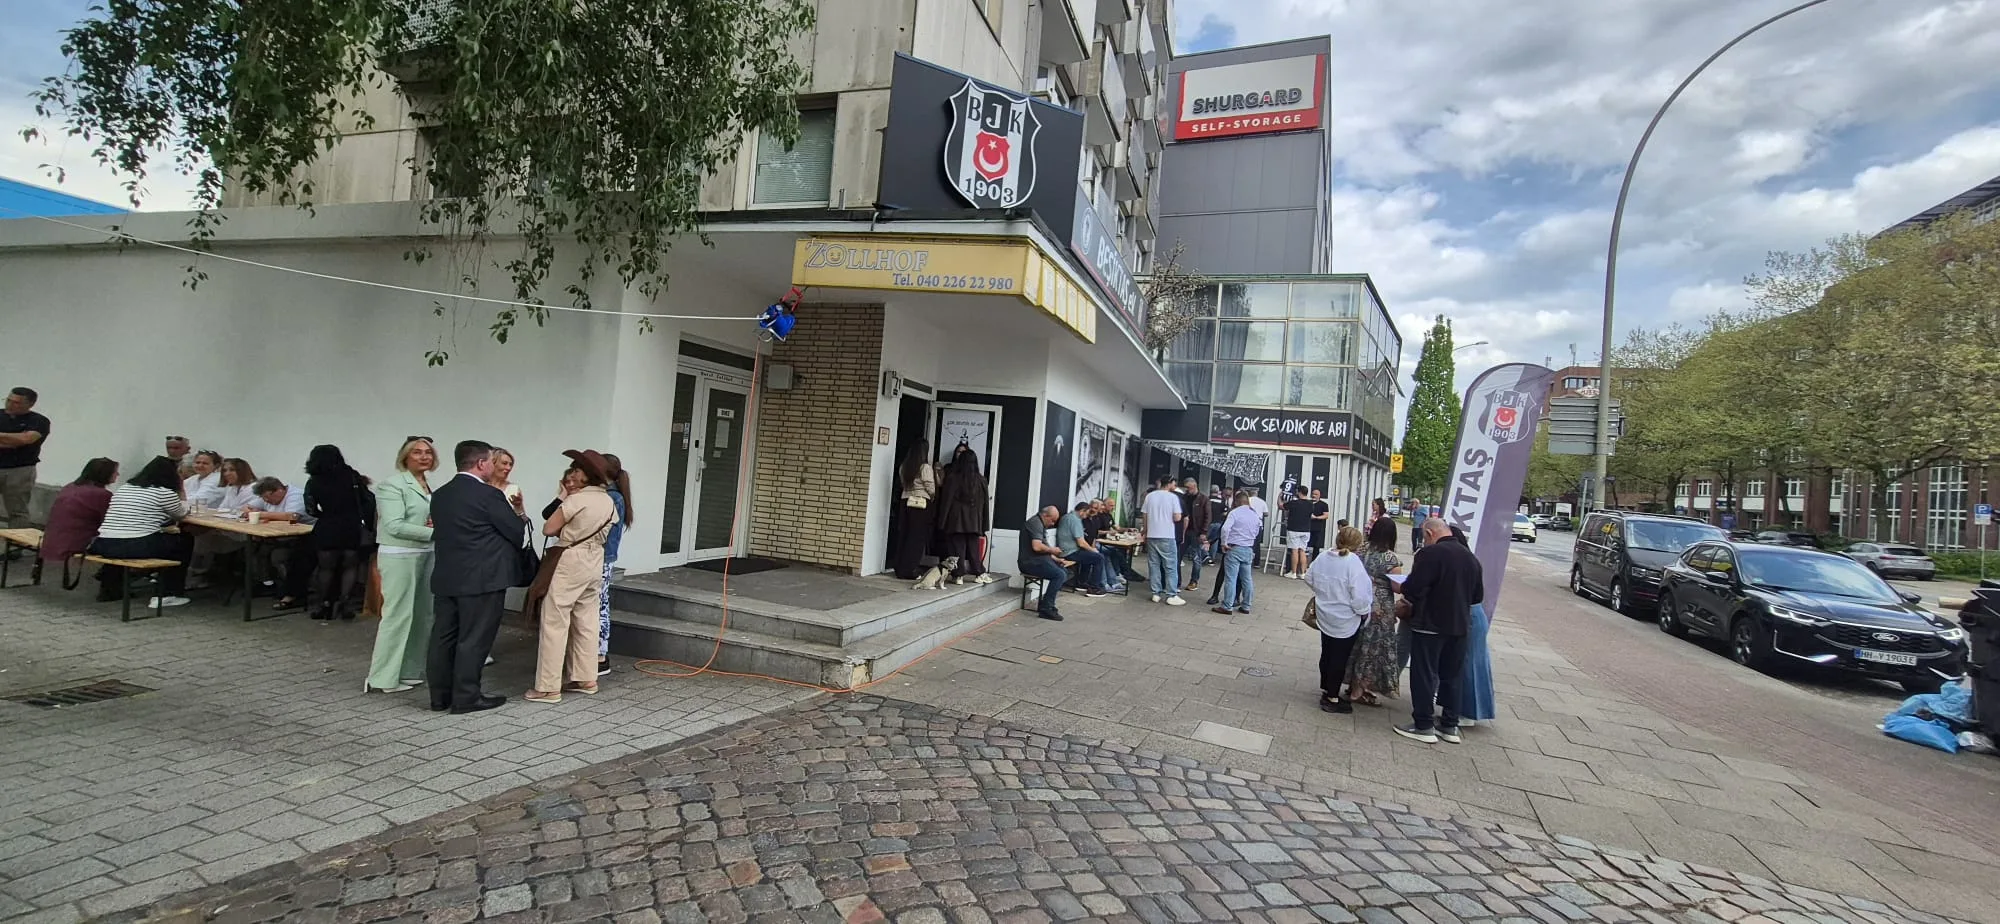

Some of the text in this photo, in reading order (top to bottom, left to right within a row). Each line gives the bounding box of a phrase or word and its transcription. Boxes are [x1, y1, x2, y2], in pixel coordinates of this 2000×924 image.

[1193, 88, 1303, 114] SHURGARD
[1191, 114, 1302, 133] SELF-STORAGE
[965, 177, 1014, 203] 1903
[804, 241, 929, 271] ZOLLHOF
[892, 272, 1013, 290] Tel. 040 226 22 980
[1233, 416, 1260, 433] ÇOK
[1309, 420, 1326, 436] BE
[1488, 428, 1516, 440] 1903
[1284, 482, 1292, 492] 9
[1449, 447, 1494, 540] KTAŞ
